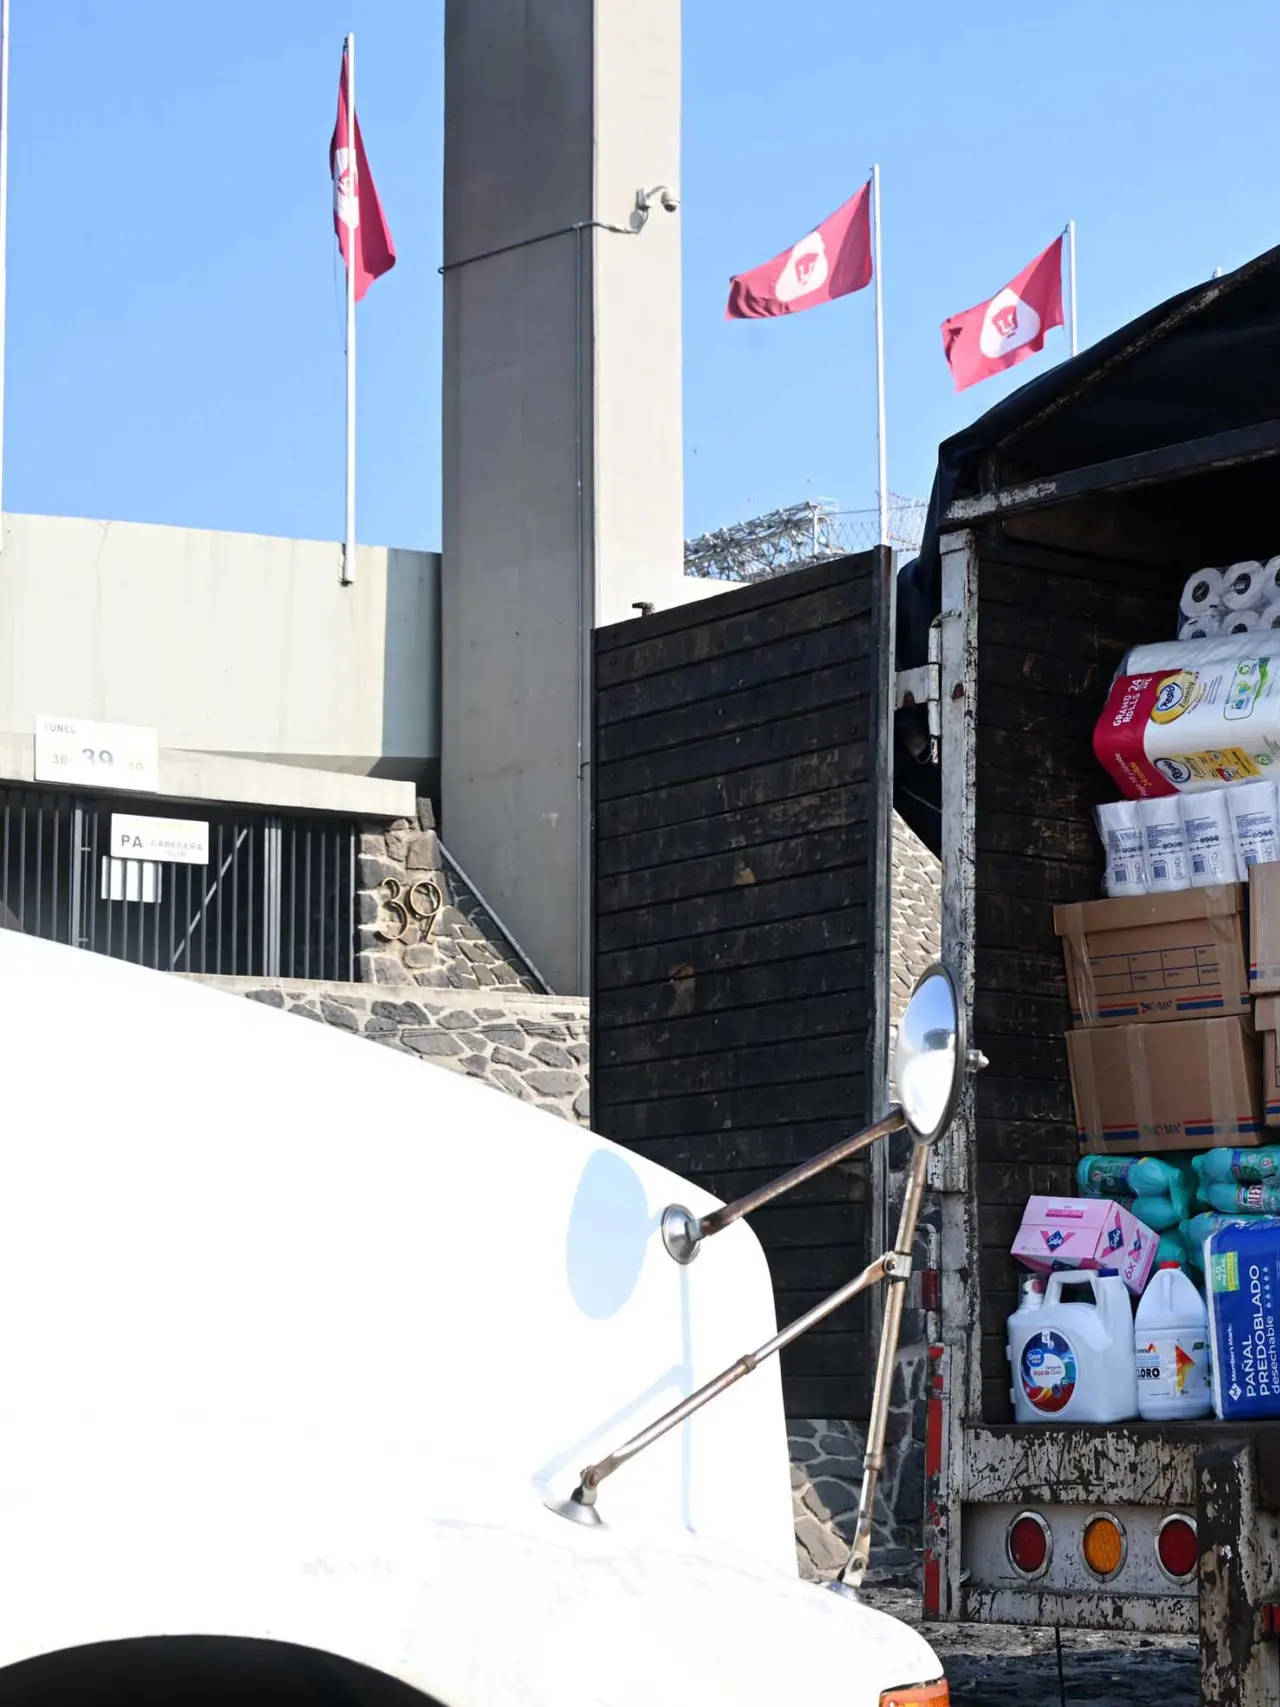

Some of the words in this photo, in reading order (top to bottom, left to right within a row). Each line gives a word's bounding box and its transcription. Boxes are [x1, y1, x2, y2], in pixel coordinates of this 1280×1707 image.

[1112, 695, 1132, 727] GRAND
[1122, 693, 1141, 724] ROLLS
[120, 834, 144, 849] PA
[375, 877, 443, 944] 39
[1249, 1265, 1270, 1396] PREDOBLADO
[1138, 1367, 1161, 1379] LORO
[1241, 1335, 1257, 1397] PAÑAL
[1265, 1316, 1280, 1394] desechable
